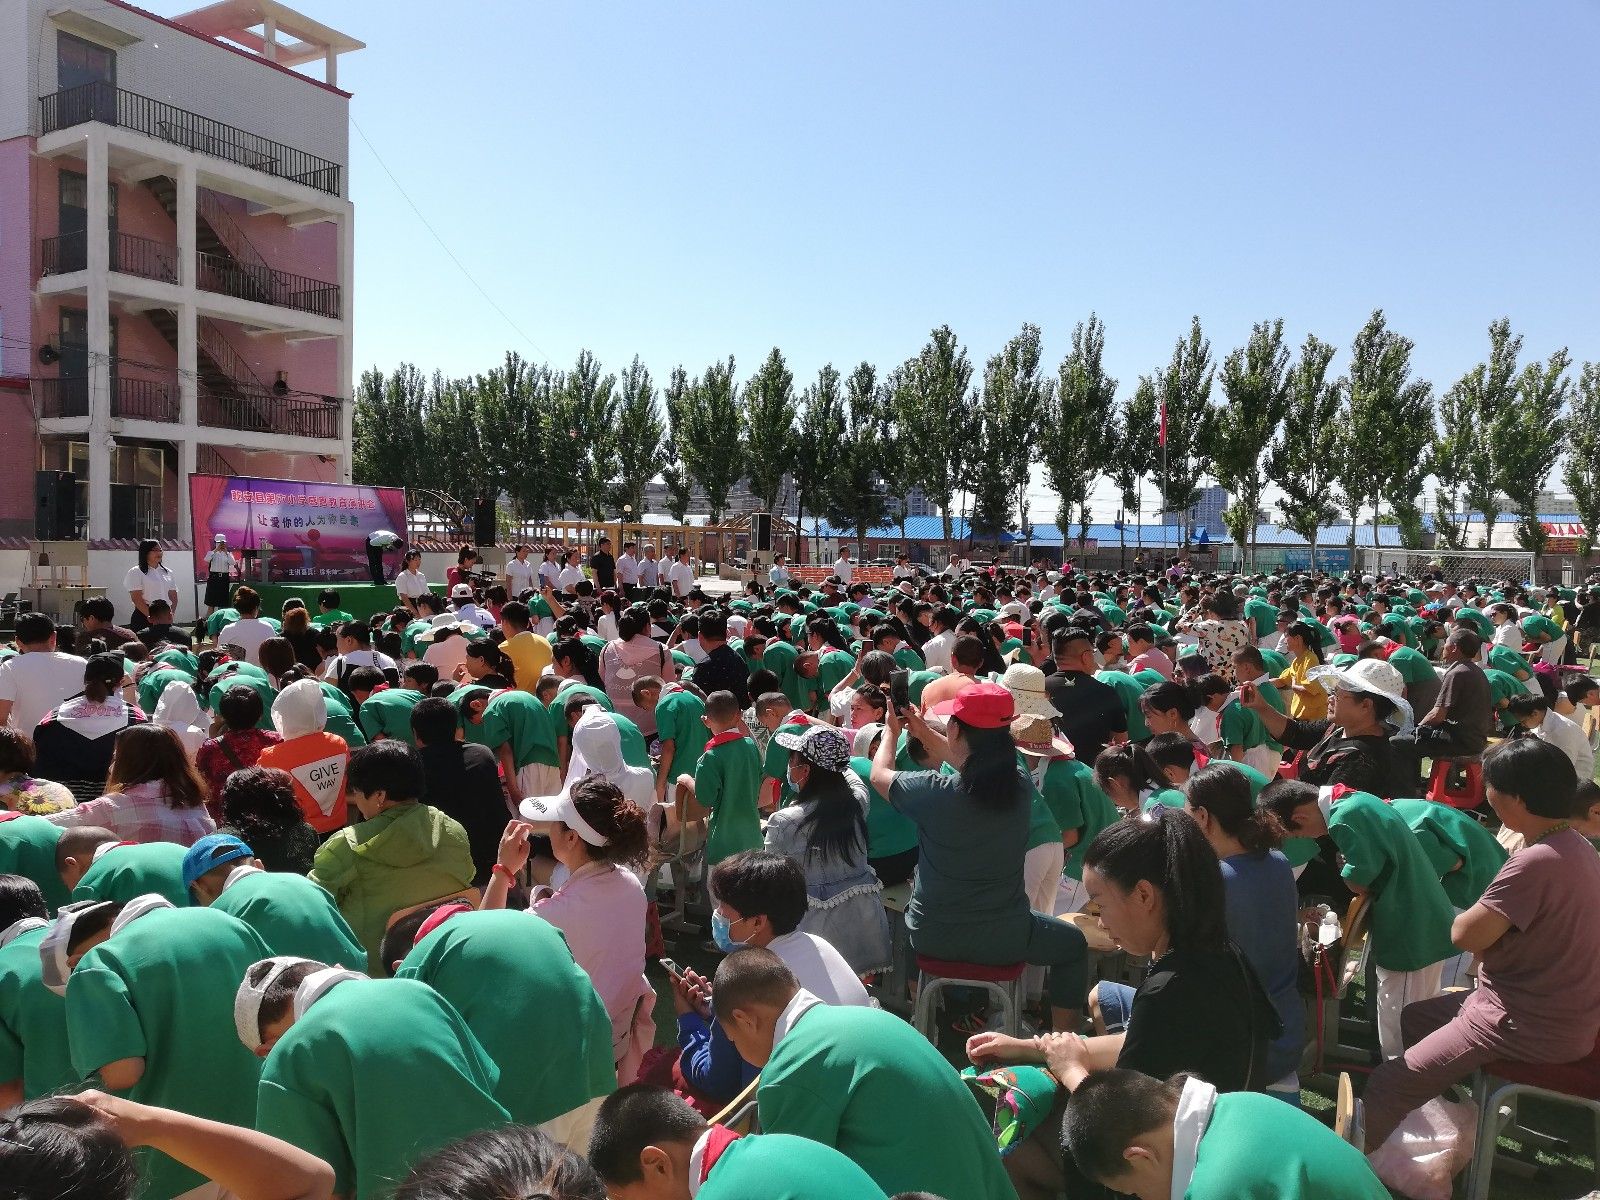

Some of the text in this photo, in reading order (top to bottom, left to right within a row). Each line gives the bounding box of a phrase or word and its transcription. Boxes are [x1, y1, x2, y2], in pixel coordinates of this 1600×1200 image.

[257, 513, 359, 528] 让爱你的人为你自豪
[309, 762, 340, 782] GIVE
[316, 778, 336, 791] WAY
